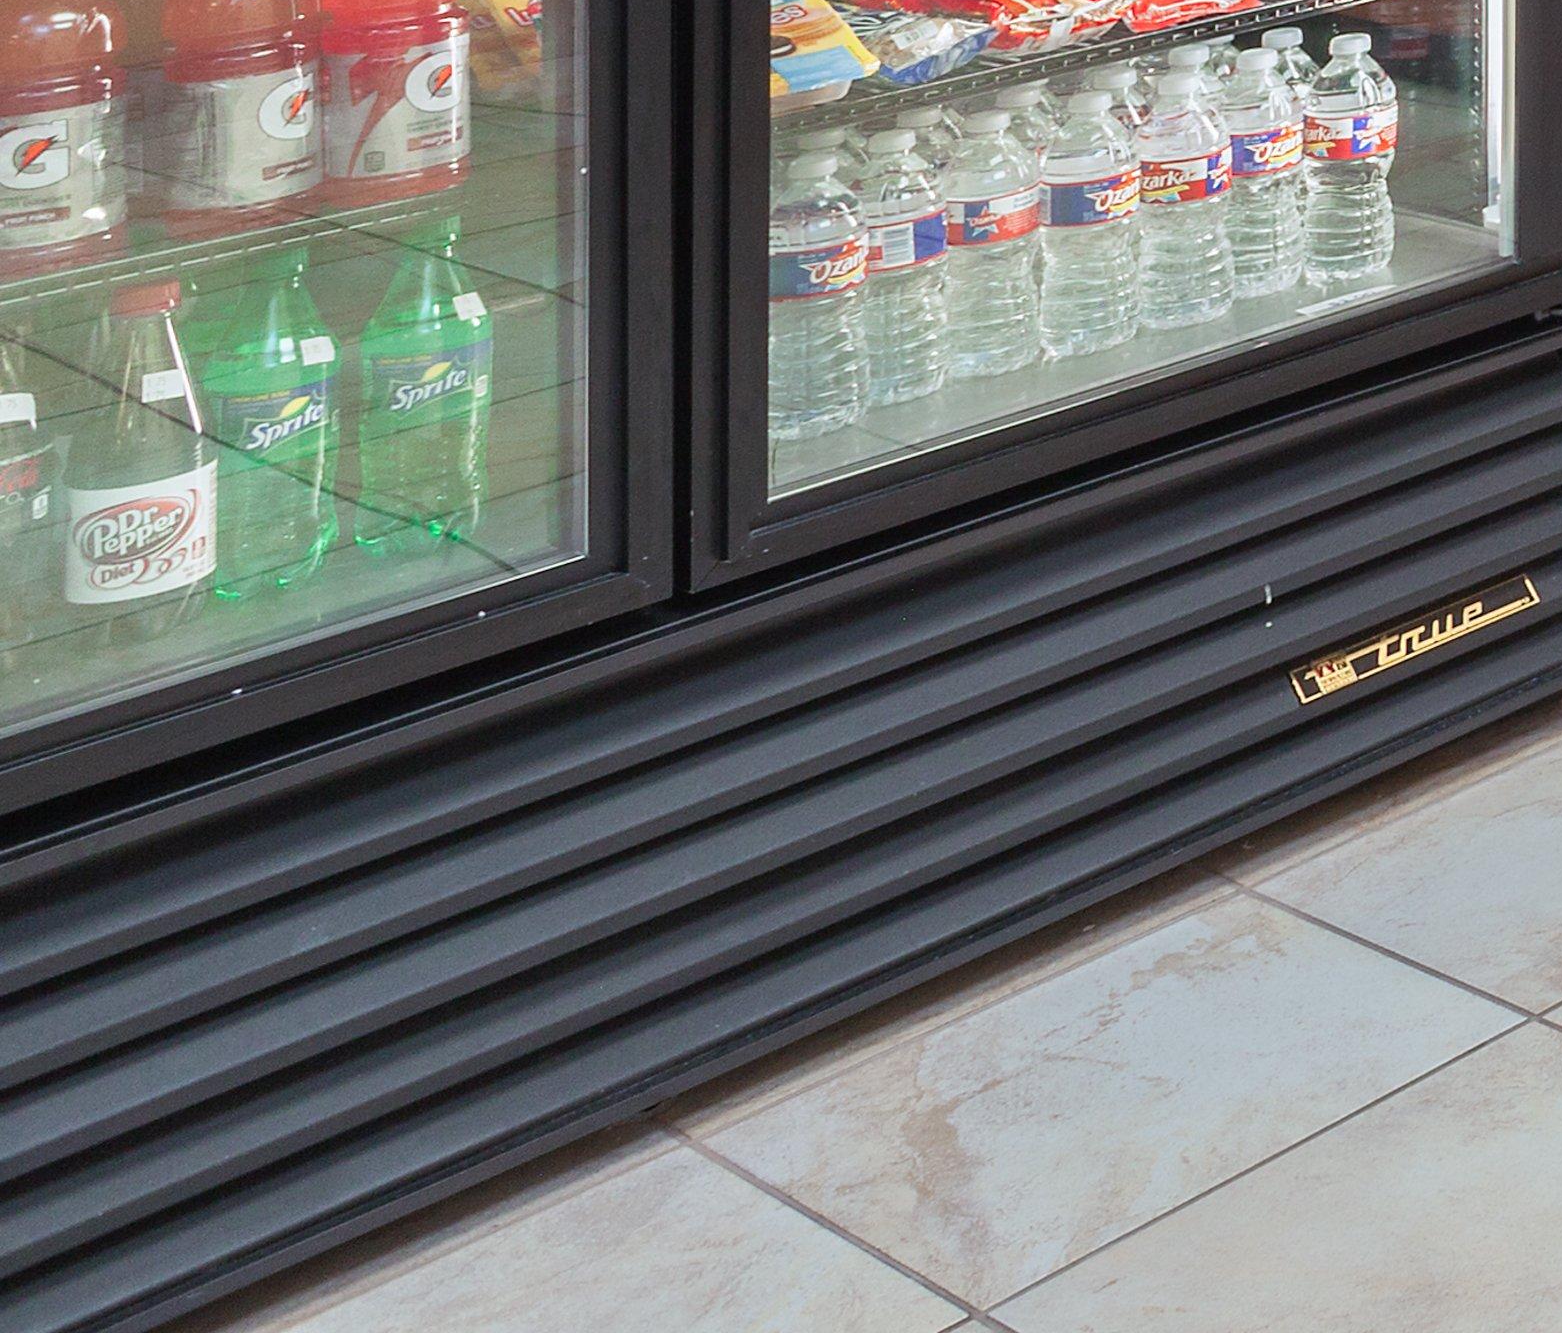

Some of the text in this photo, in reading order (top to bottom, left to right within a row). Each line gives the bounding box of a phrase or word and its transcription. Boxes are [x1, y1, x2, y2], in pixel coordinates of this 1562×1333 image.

[388, 366, 469, 411] Sprite
[244, 401, 328, 452] Sprite
[91, 503, 183, 558] Pepper
[119, 504, 158, 534] Dr
[100, 560, 136, 586] Diet
